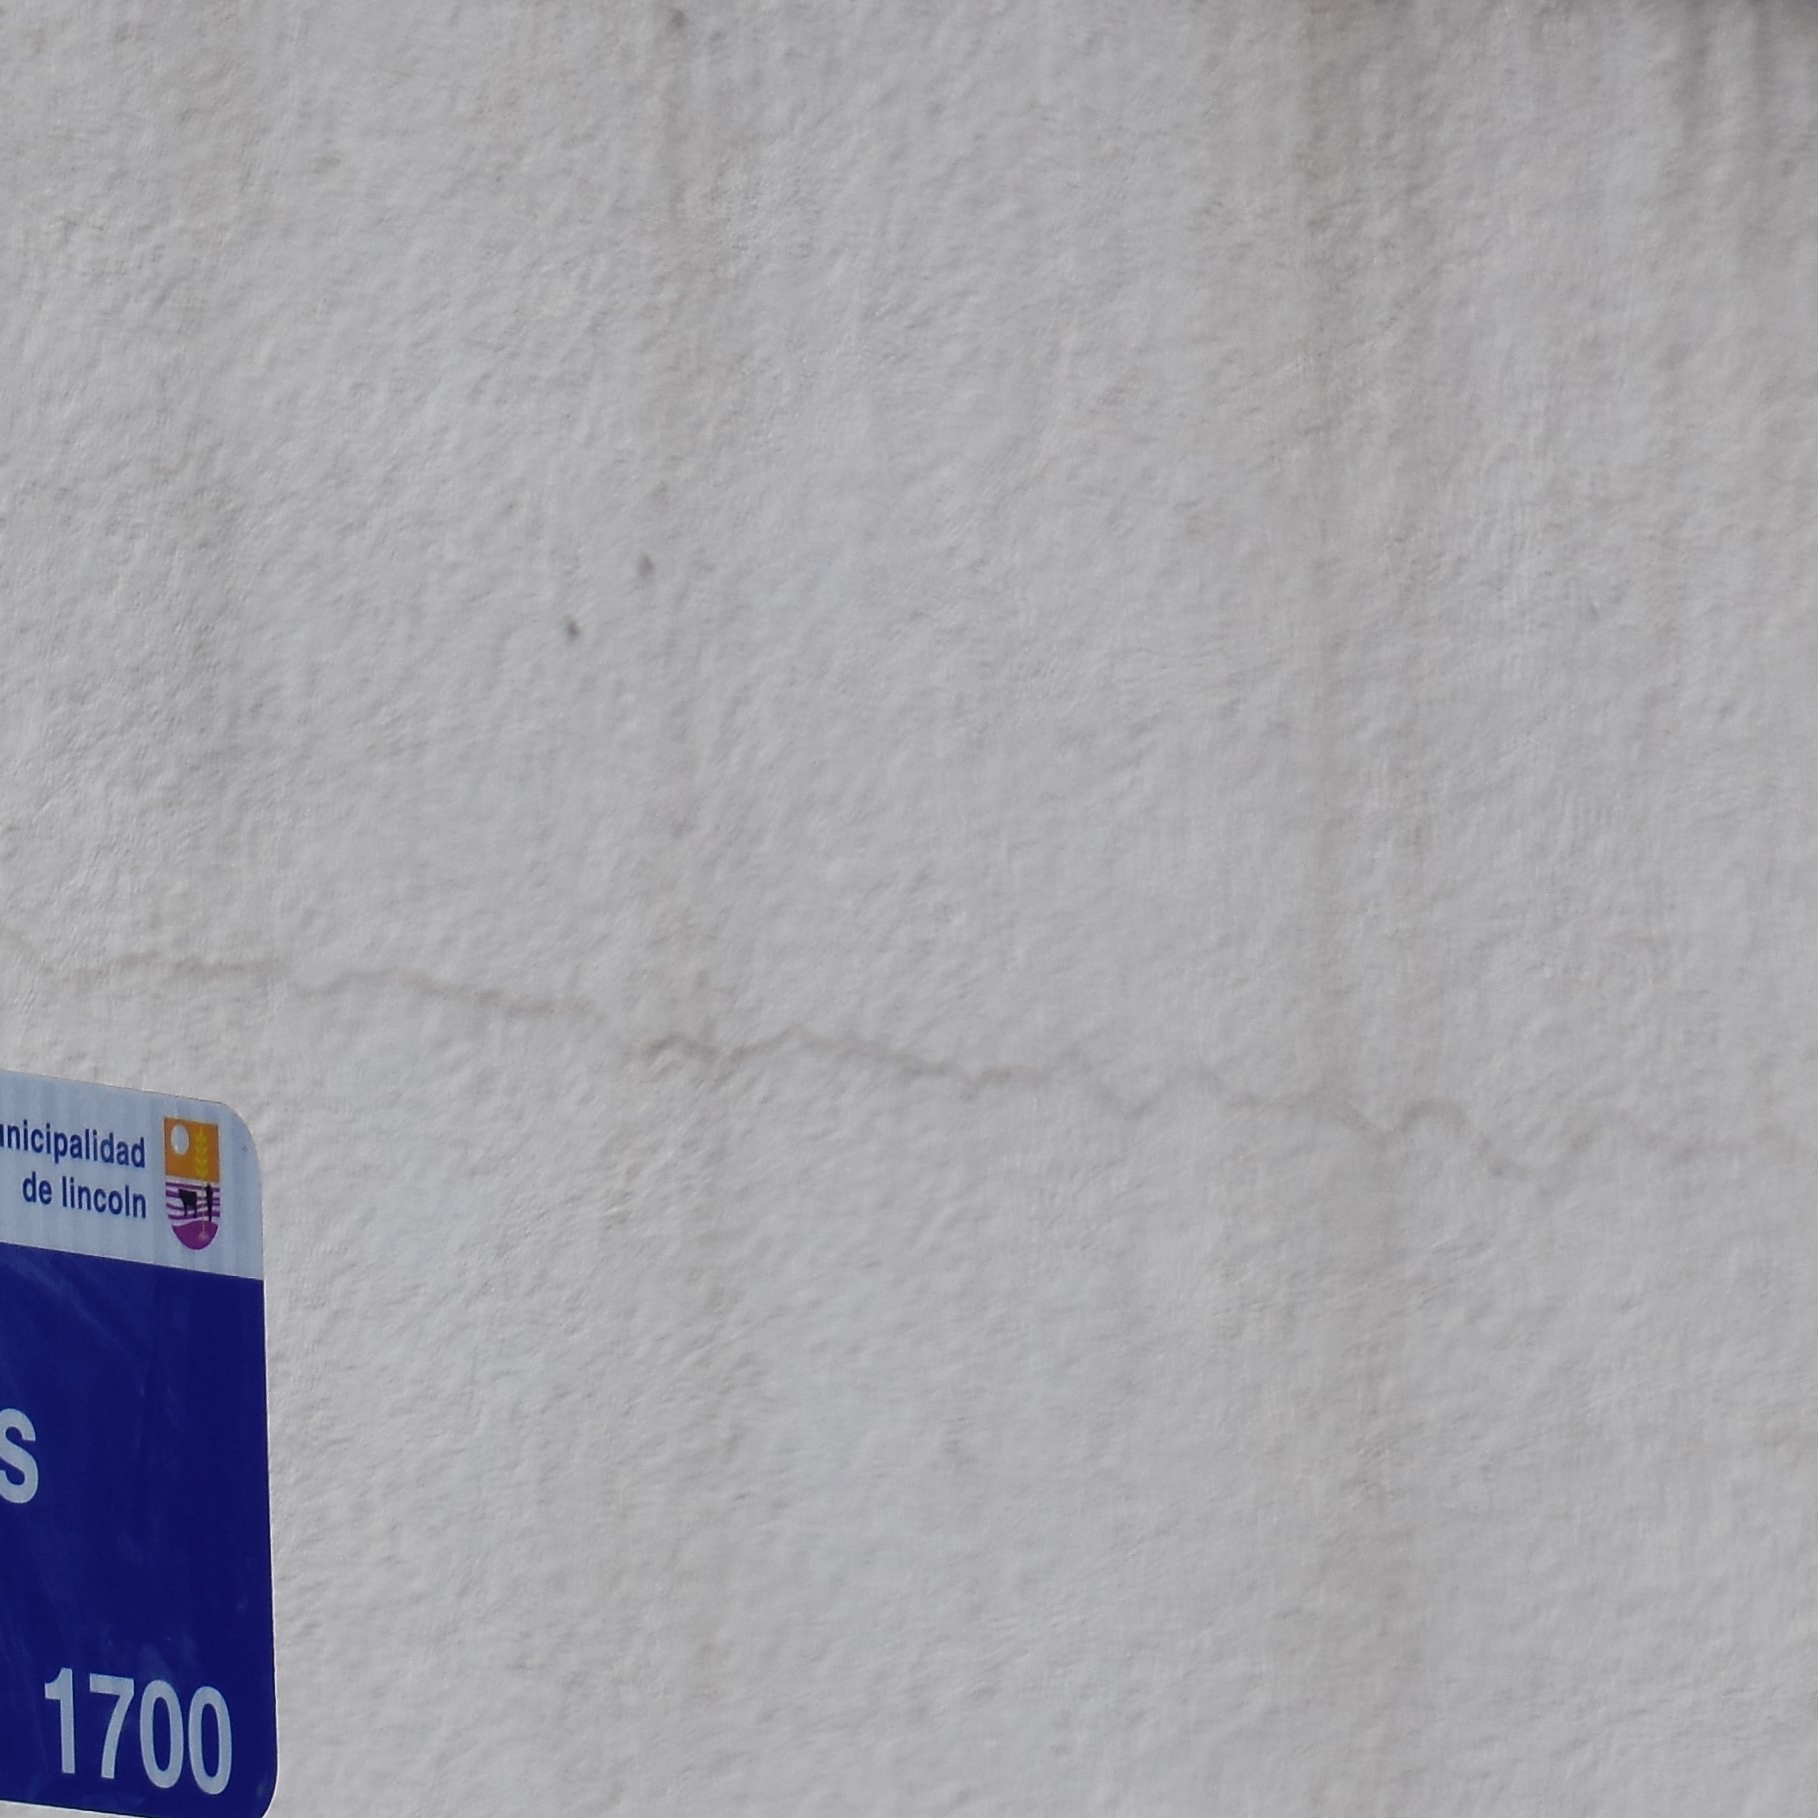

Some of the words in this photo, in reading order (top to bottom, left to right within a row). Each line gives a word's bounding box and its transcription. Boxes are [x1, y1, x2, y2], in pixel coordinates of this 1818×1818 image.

[23, 1172, 53, 1205] de
[62, 1175, 147, 1219] lincoln
[44, 1667, 232, 1795] 1700
